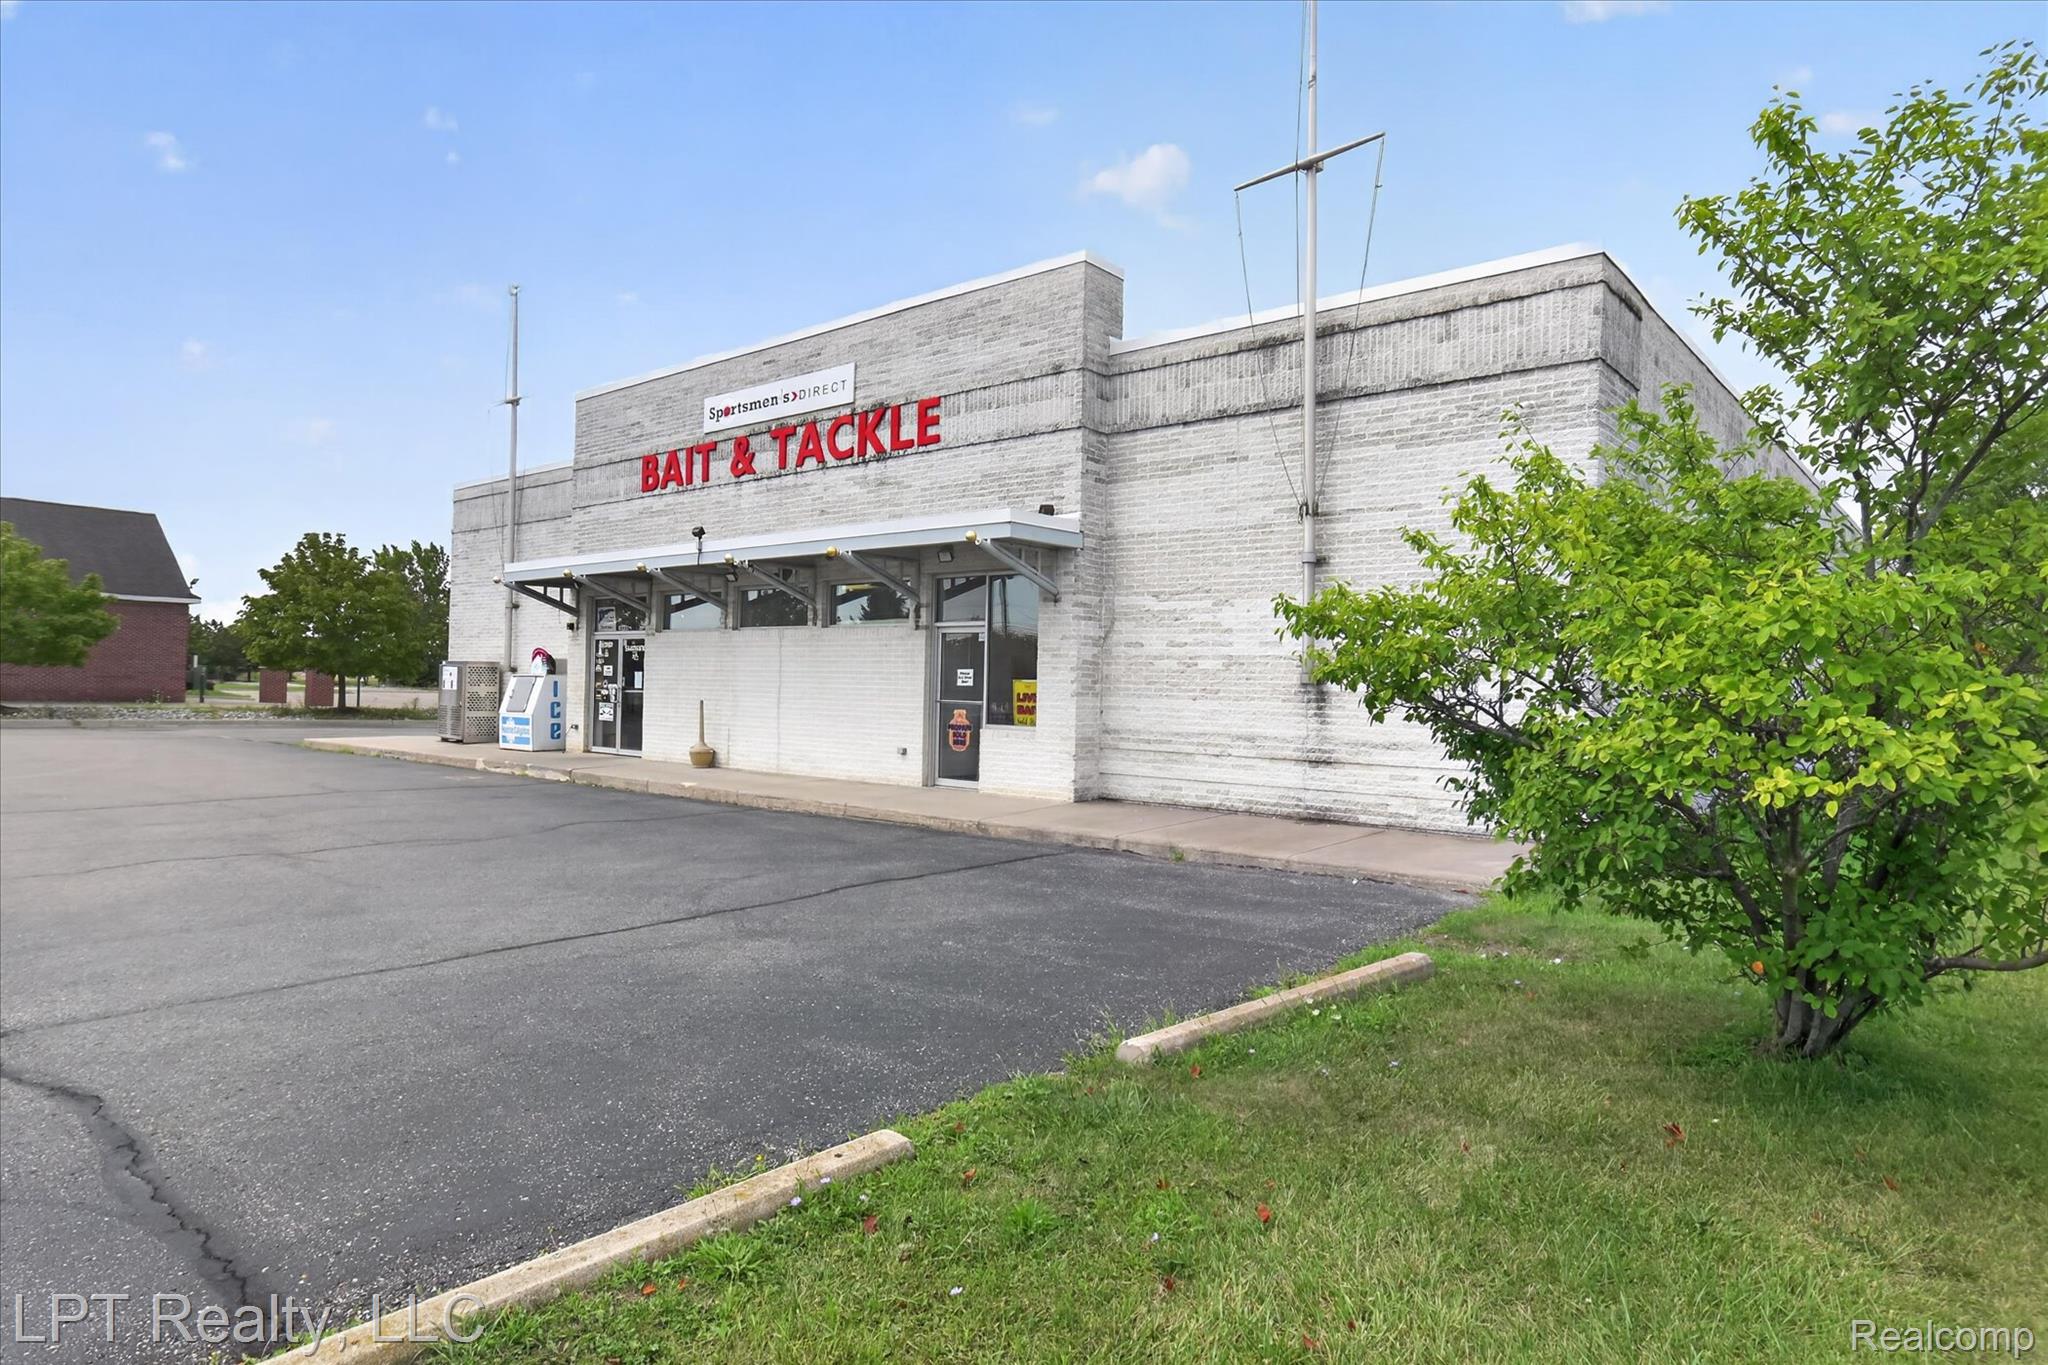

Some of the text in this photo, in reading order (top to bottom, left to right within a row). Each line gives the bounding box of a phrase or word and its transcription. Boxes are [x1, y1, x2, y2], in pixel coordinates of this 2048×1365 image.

[709, 379, 847, 422] Sportsmen's DIRECT
[641, 396, 941, 493] BAIT & TACKLE
